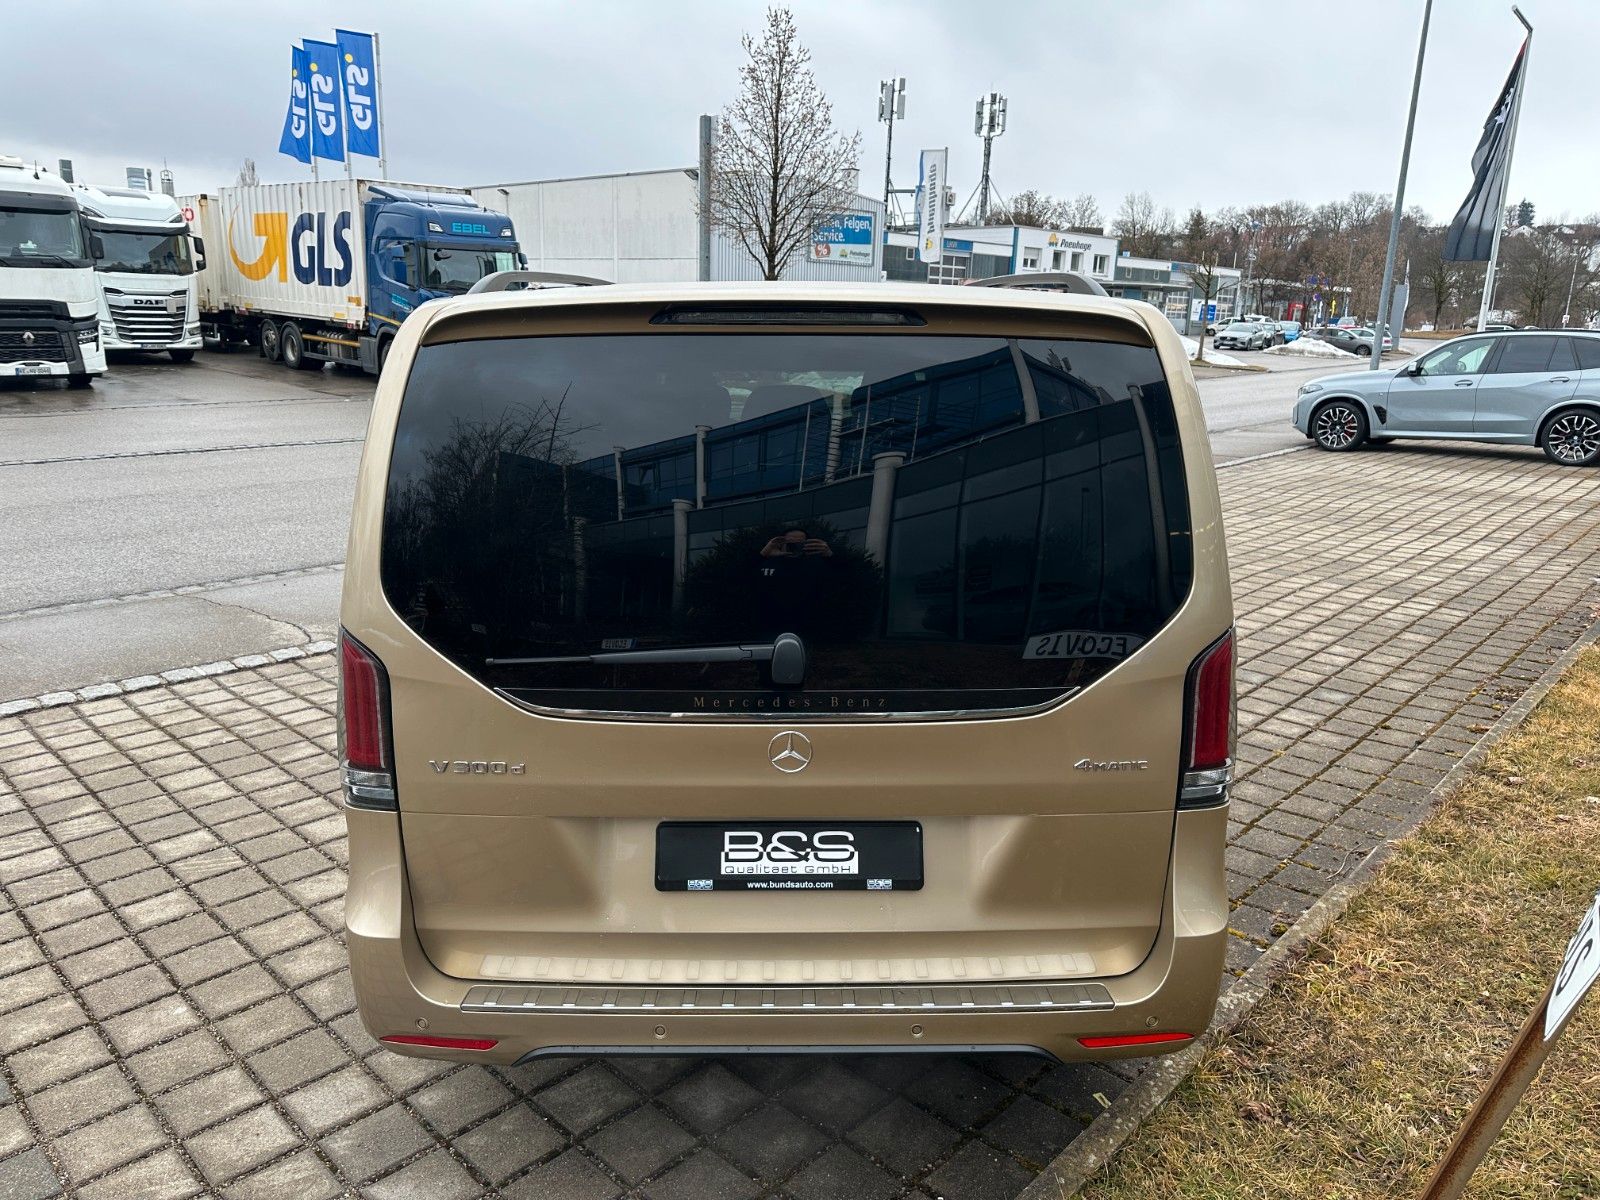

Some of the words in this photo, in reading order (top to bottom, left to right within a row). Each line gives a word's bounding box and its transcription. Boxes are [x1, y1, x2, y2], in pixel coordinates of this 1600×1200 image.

[452, 222, 490, 234] EBEL
[843, 216, 872, 233] Felgen,
[291, 210, 353, 287] GLS
[1060, 238, 1092, 252] Pneuhage
[693, 696, 886, 709] Mercedes-Benz
[428, 760, 526, 775] V300d
[723, 830, 856, 863] B&S
[724, 863, 798, 875] Qualitaet
[804, 863, 851, 874] GmbH
[746, 880, 834, 889] www.bundsauto.com
